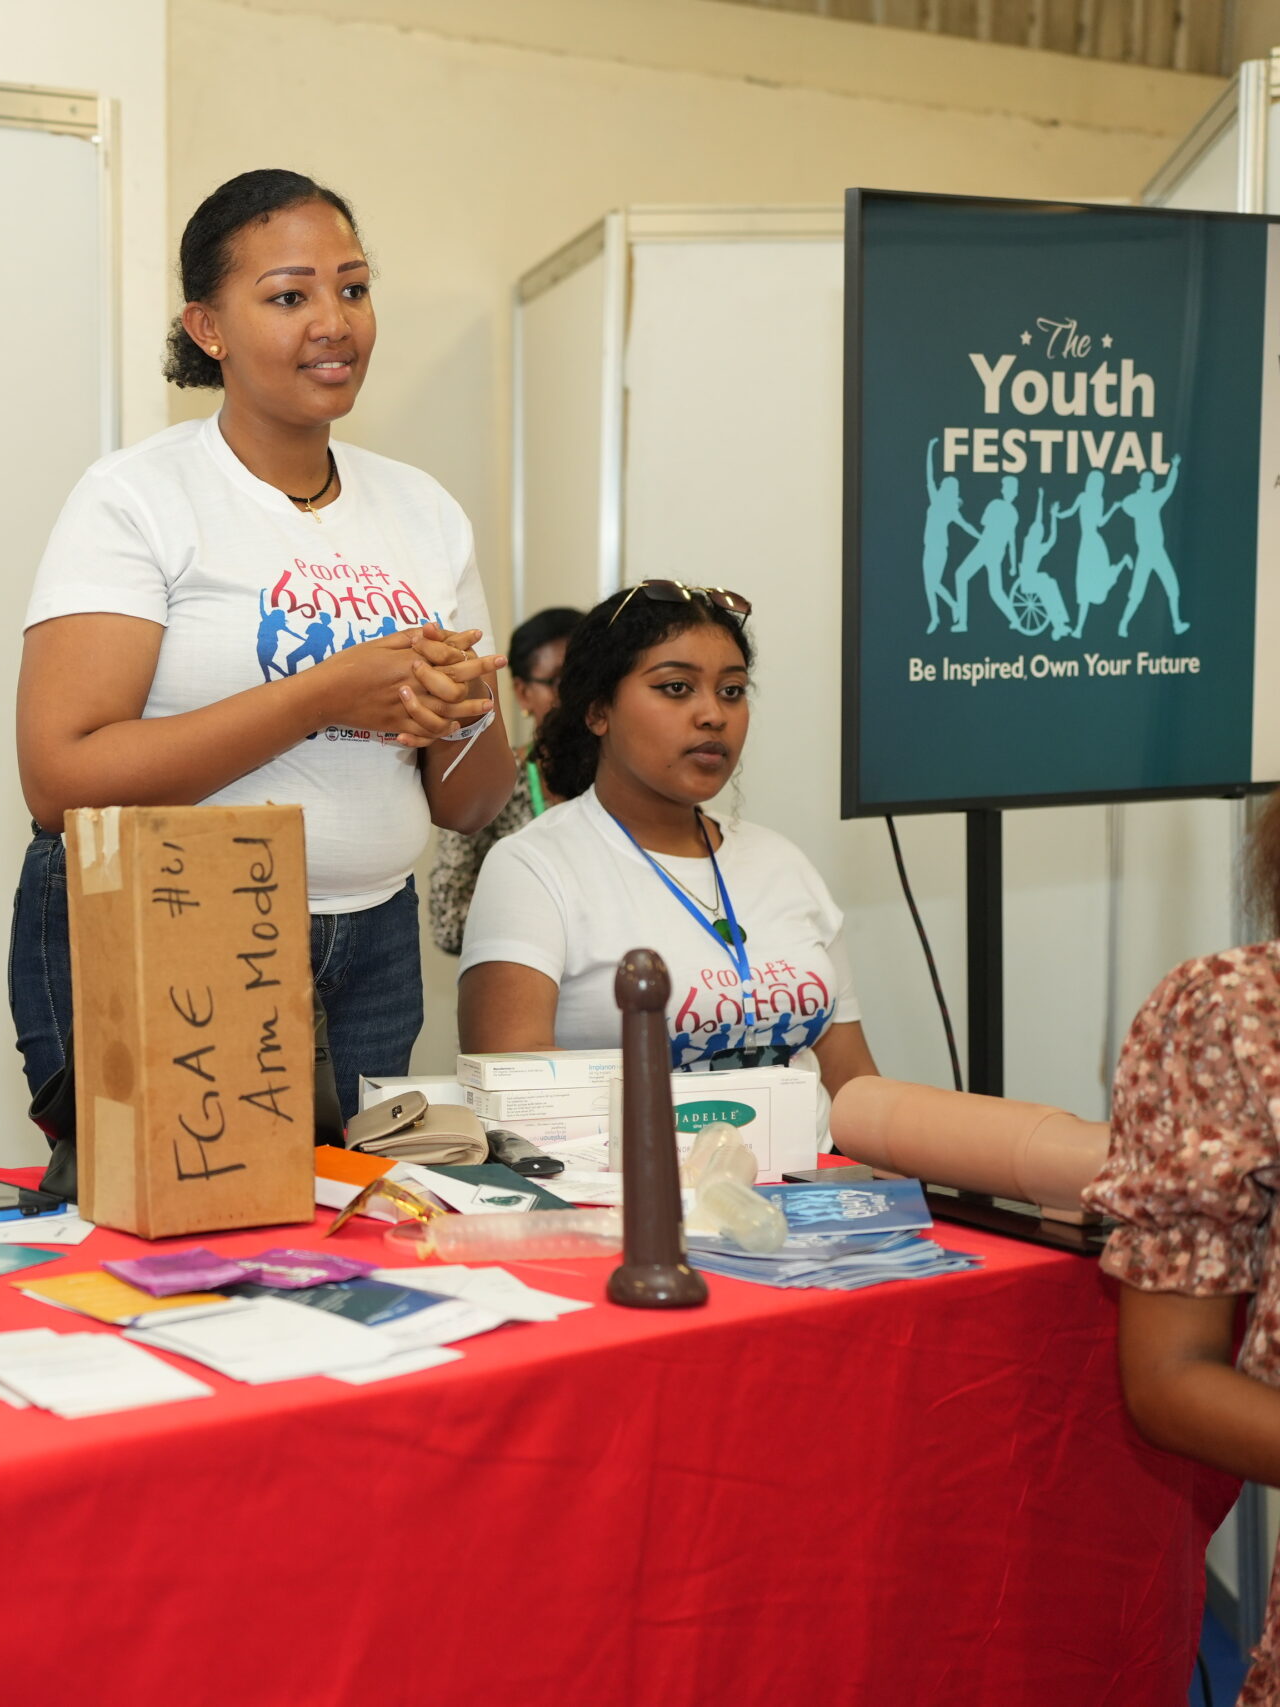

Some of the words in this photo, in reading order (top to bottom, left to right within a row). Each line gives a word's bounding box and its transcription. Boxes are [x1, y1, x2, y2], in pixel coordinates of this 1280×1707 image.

[1036, 316, 1092, 360] The
[968, 353, 1156, 418] Youth
[943, 427, 1172, 475] FESTIVAL
[908, 657, 937, 682] Be
[942, 655, 1028, 688] Inspired,
[1030, 653, 1080, 679] Own
[1083, 653, 1132, 677] Your
[1136, 651, 1201, 676] Future
[340, 729, 370, 739] USAID
[232, 837, 281, 991] Model
[169, 985, 247, 1182] FGAE
[238, 1005, 294, 1123] Arm
